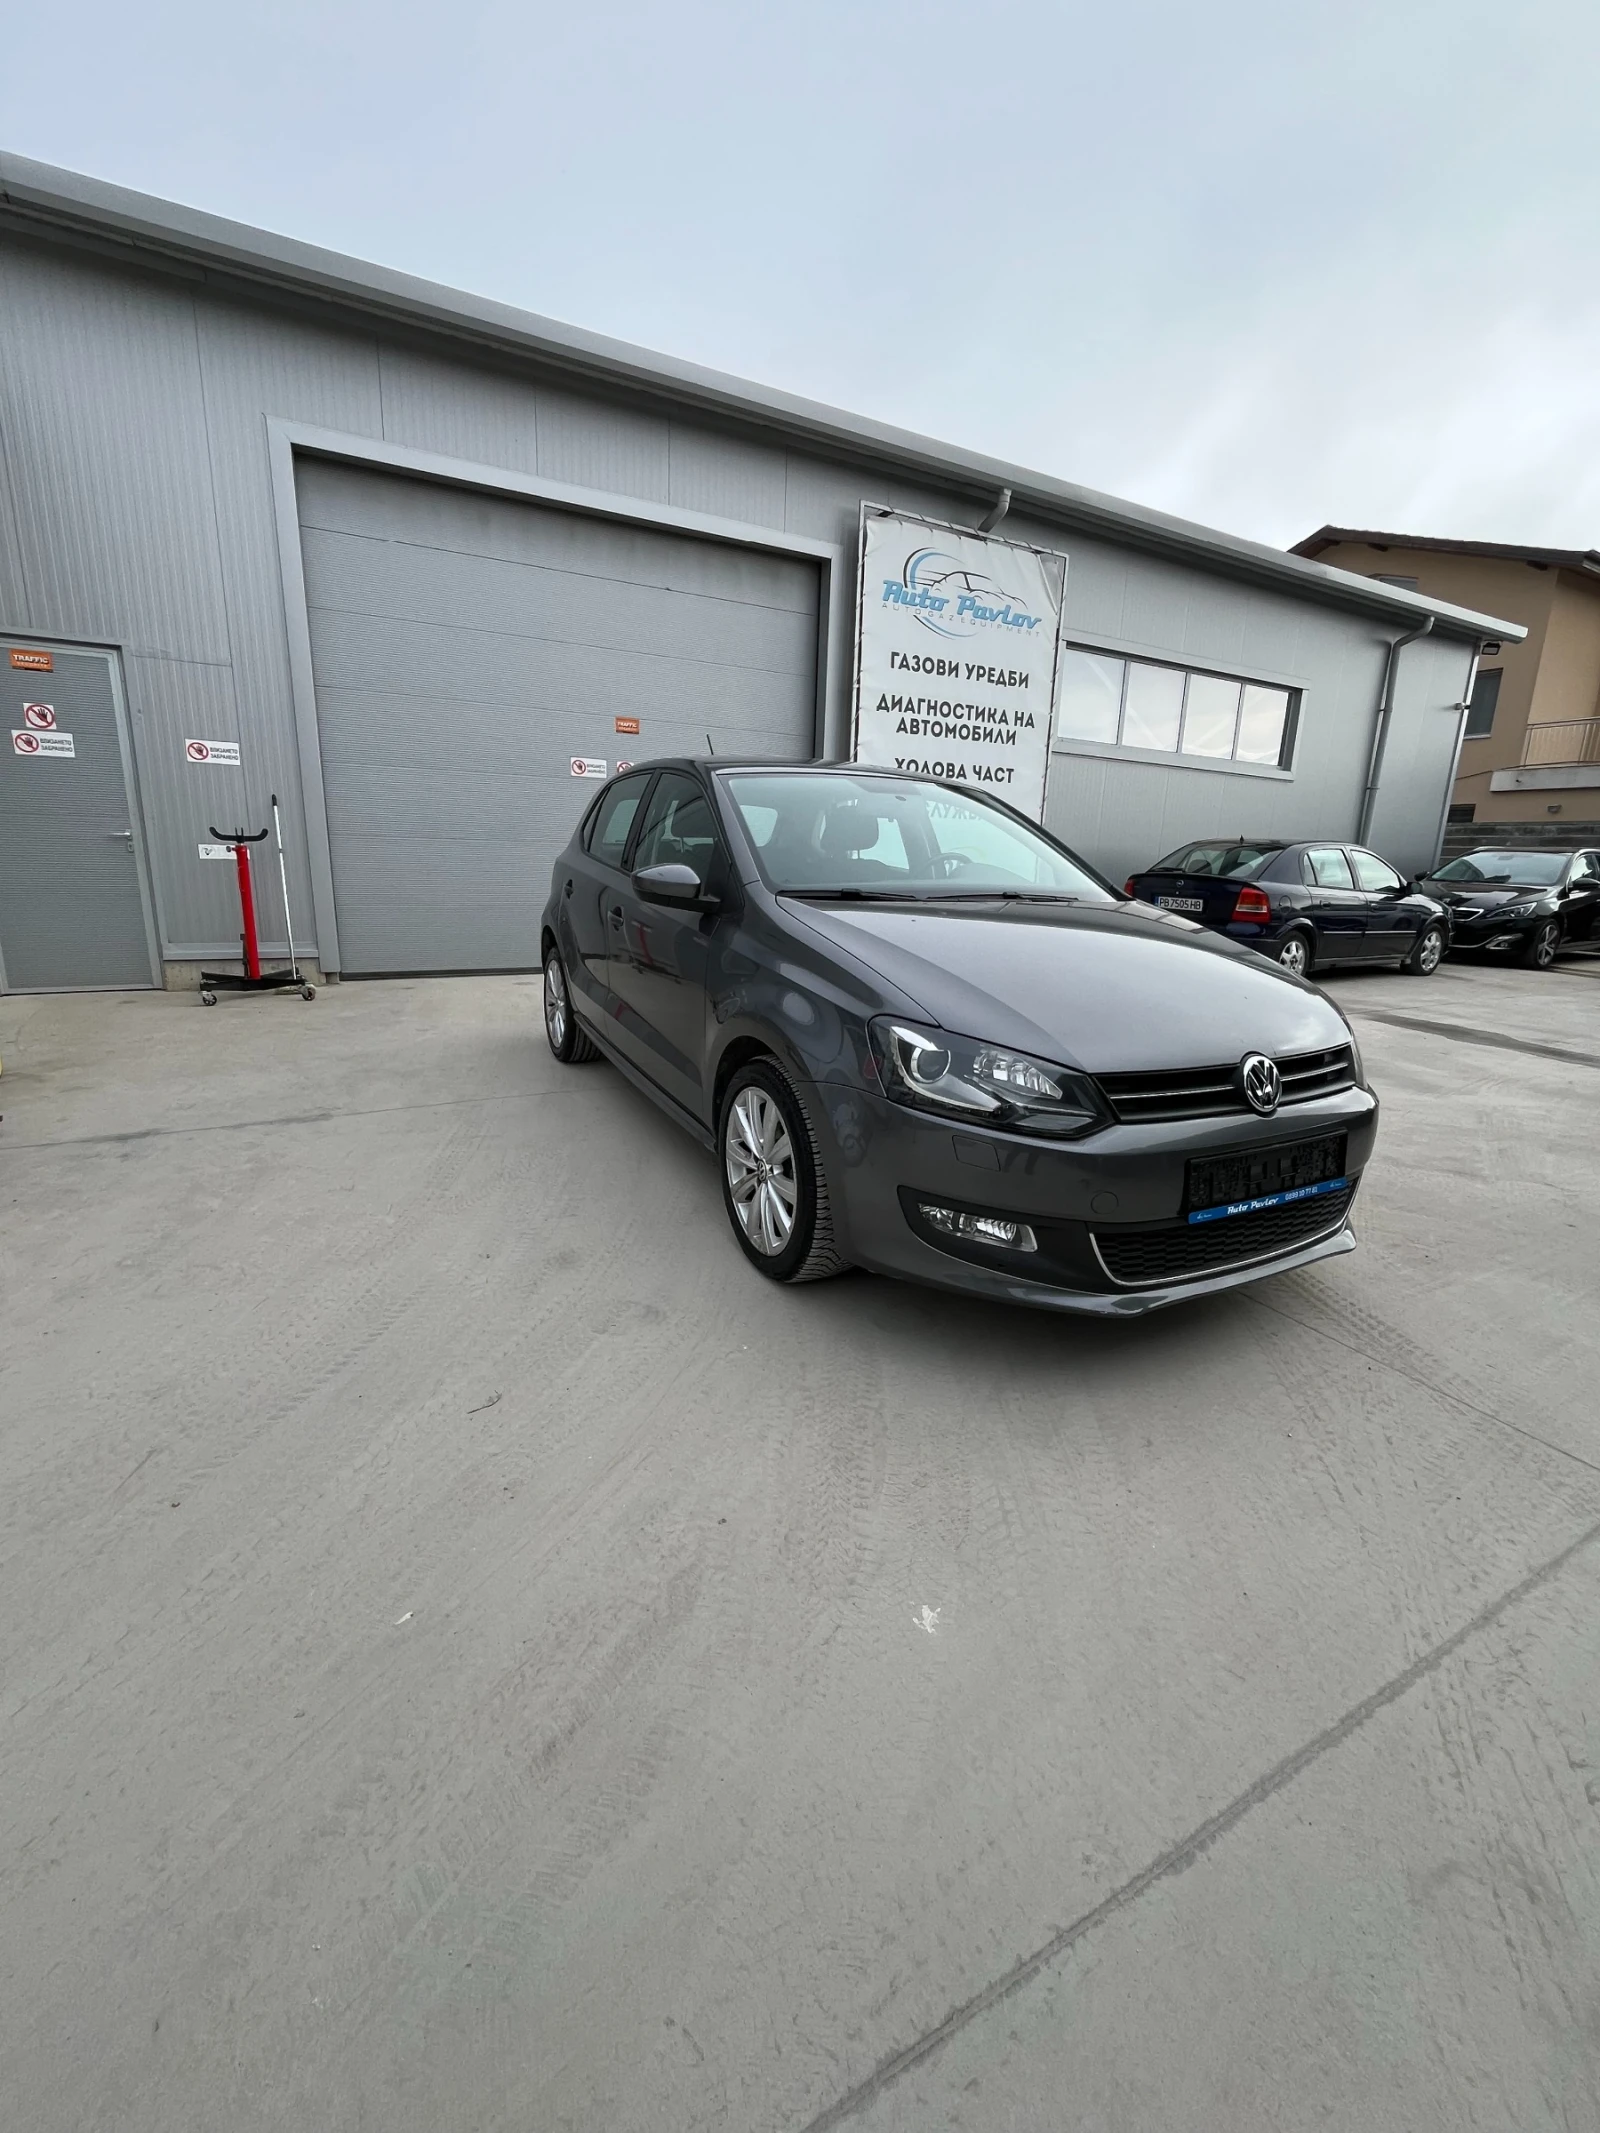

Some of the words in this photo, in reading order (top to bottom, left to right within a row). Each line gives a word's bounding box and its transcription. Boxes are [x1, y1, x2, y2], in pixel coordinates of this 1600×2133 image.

[882, 579, 950, 611] Auto
[957, 594, 1042, 629] Pavlov
[13, 654, 49, 664] TRAFFIC
[890, 651, 959, 678] ГАЗОВИ
[965, 663, 1029, 688] УРЕДБИ
[876, 693, 1009, 725] ДИАГНОСТИКА
[1014, 710, 1035, 728] НА
[896, 717, 1017, 745] АВТОМОБИЛИ
[973, 765, 1014, 783] ЧАСТ
[1170, 899, 1189, 909] 7505
[1227, 1205, 1248, 1214] Auto
